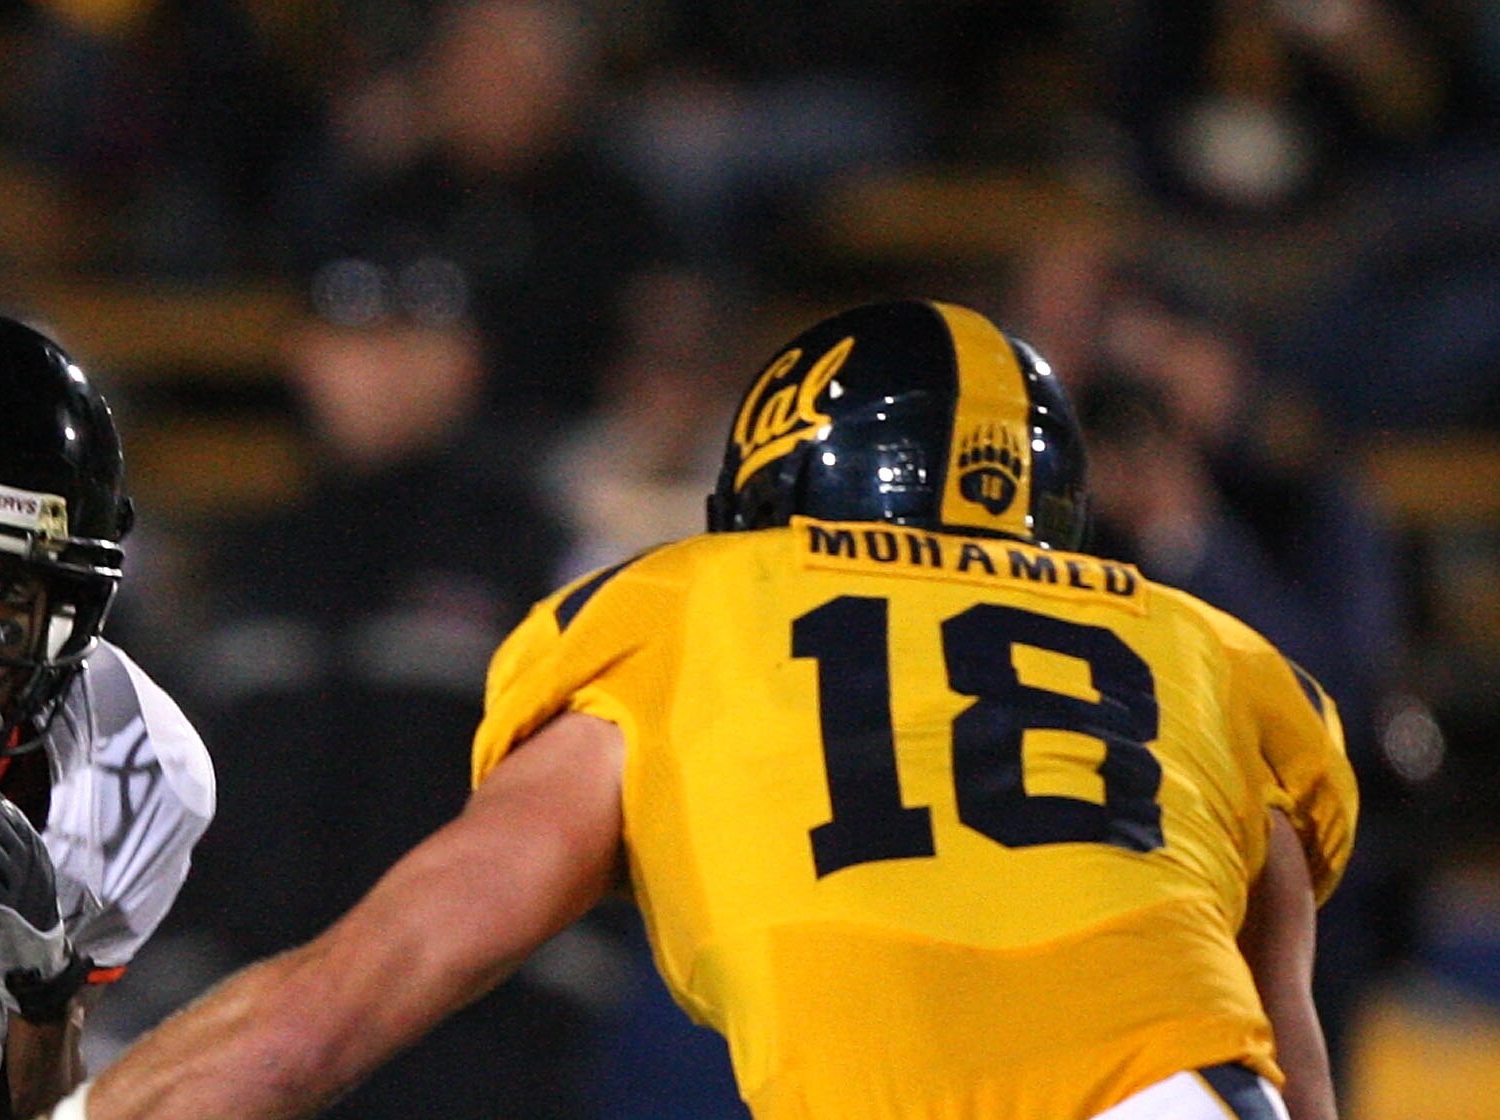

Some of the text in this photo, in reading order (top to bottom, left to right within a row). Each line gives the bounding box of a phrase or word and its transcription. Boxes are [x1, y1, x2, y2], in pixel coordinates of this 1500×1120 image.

[733, 336, 855, 462] Cal
[808, 524, 1137, 598] MOHAMED
[791, 595, 1166, 881] 18
